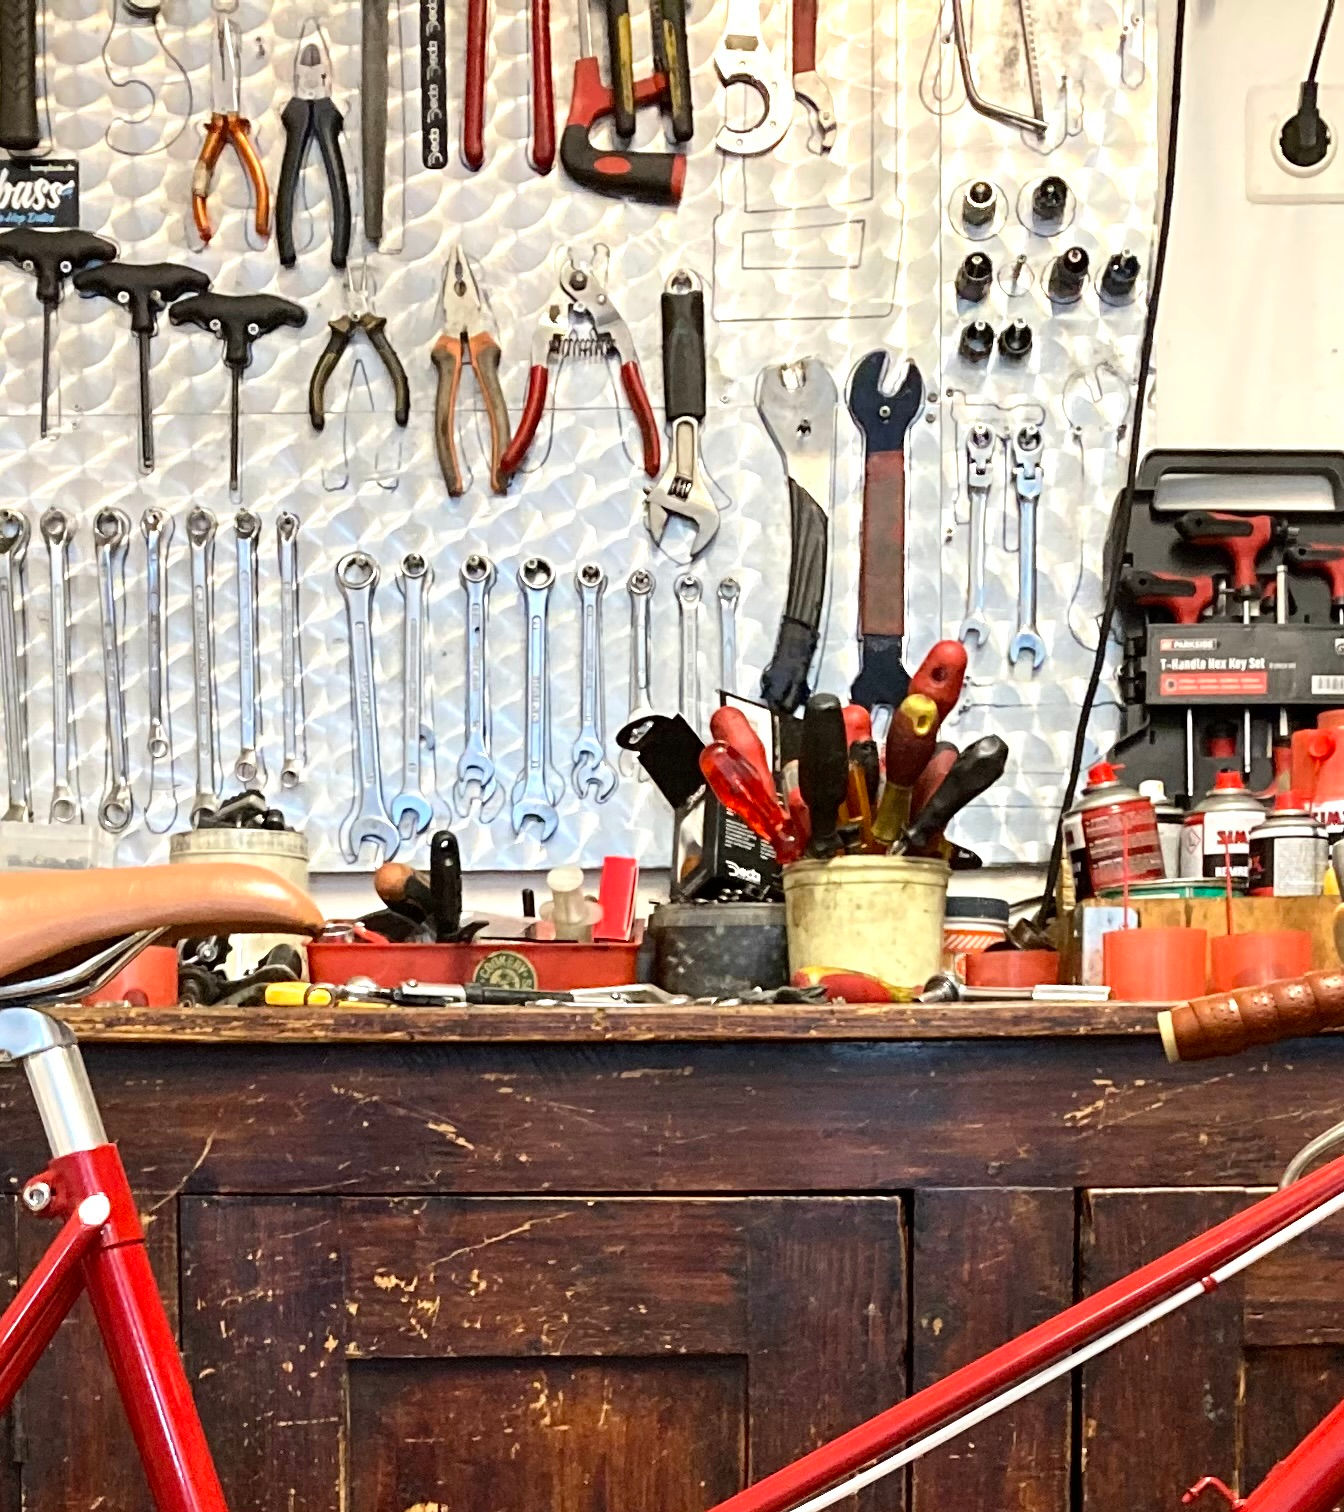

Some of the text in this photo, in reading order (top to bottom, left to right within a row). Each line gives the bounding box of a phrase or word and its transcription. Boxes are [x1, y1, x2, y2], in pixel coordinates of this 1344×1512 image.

[1160, 658, 1206, 670] T-Handle
[1208, 658, 1227, 670] Hex
[1228, 657, 1248, 671] Key
[1248, 657, 1266, 669] Set
